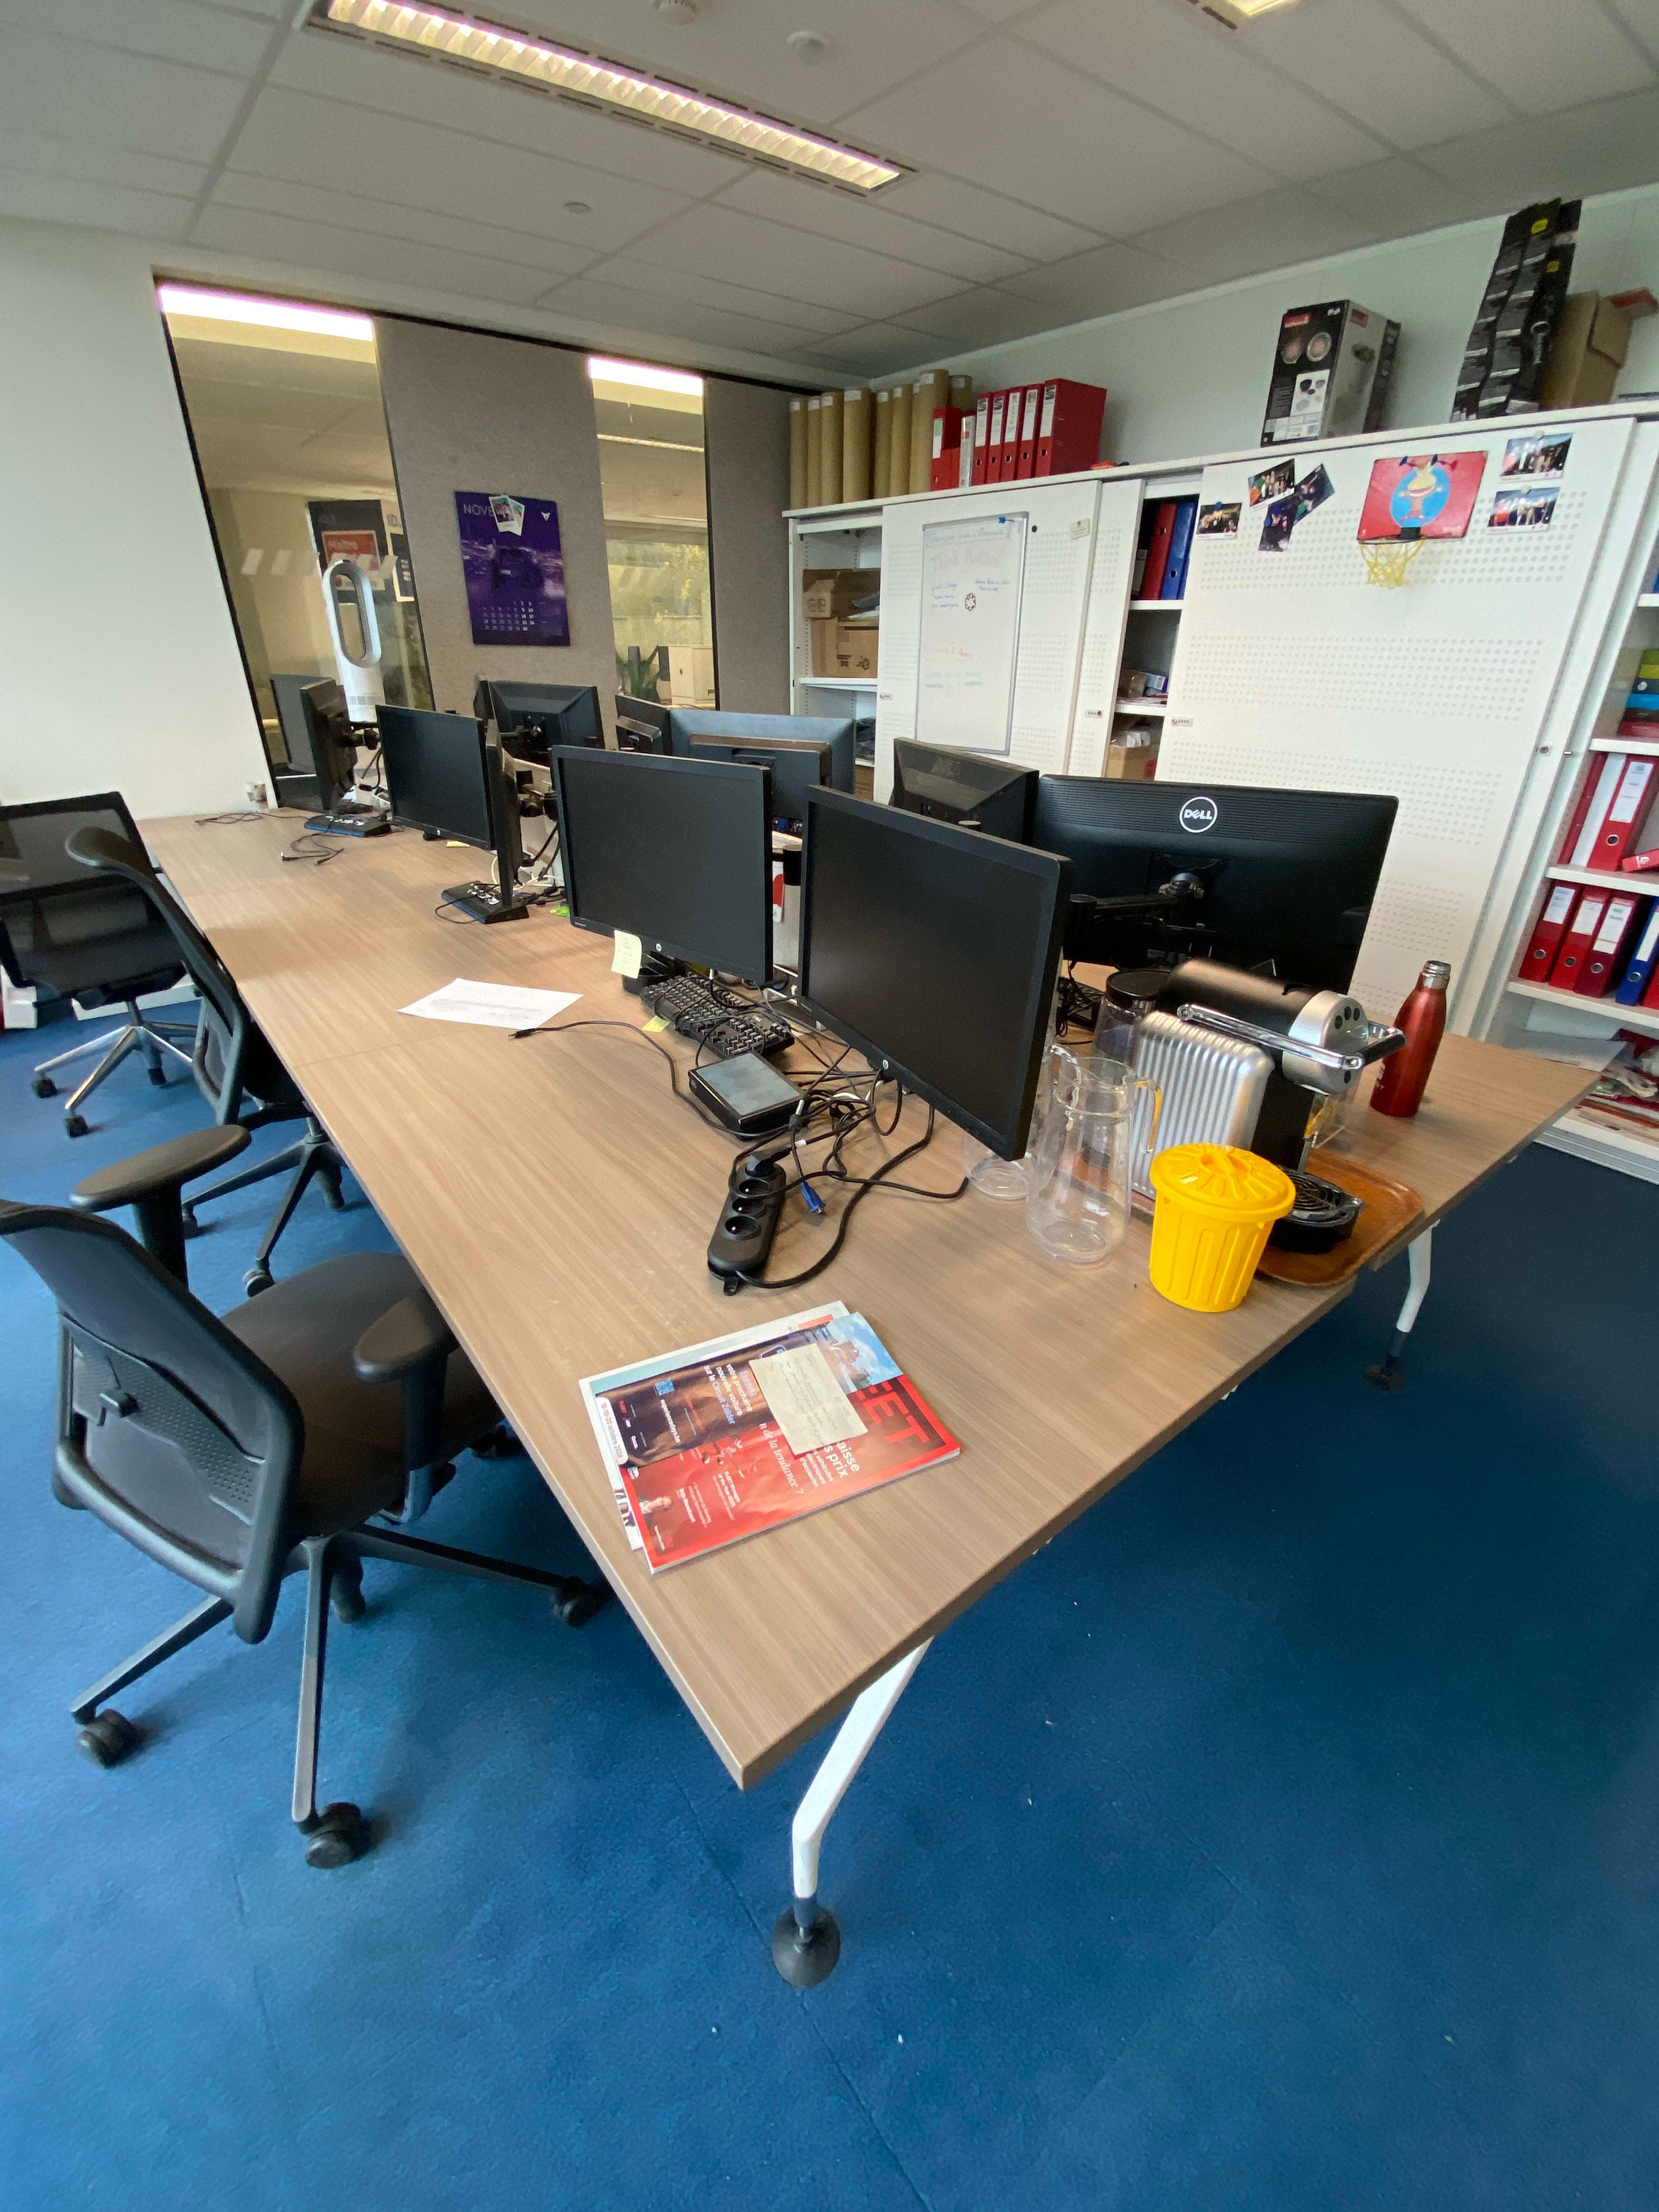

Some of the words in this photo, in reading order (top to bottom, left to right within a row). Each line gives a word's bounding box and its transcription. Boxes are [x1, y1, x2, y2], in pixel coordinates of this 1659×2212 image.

[463, 503, 494, 517] NOVE
[1183, 809, 1212, 820] DELL
[703, 1364, 713, 1375] sur
[708, 1374, 717, 1382] le
[711, 1380, 726, 1403] Circuit
[715, 1365, 733, 1393] nouvelle
[727, 1392, 743, 1416] voiture
[725, 1363, 738, 1380] votre
[732, 1379, 754, 1412] prochaine
[721, 1402, 736, 1425] Zolder
[600, 1402, 613, 1425] 18-19-20
[607, 1424, 619, 1444] octobre
[614, 1444, 623, 1458] 2024
[757, 1421, 769, 1431] n
[761, 1427, 775, 1440] de
[768, 1437, 781, 1449] la
[823, 1443, 834, 1453] s
[825, 1452, 851, 1479] prix
[836, 1439, 861, 1473] aisse
[772, 1448, 802, 1489] tendance
[799, 1456, 820, 1488] d'occasion
[815, 1453, 835, 1483] véhicules
